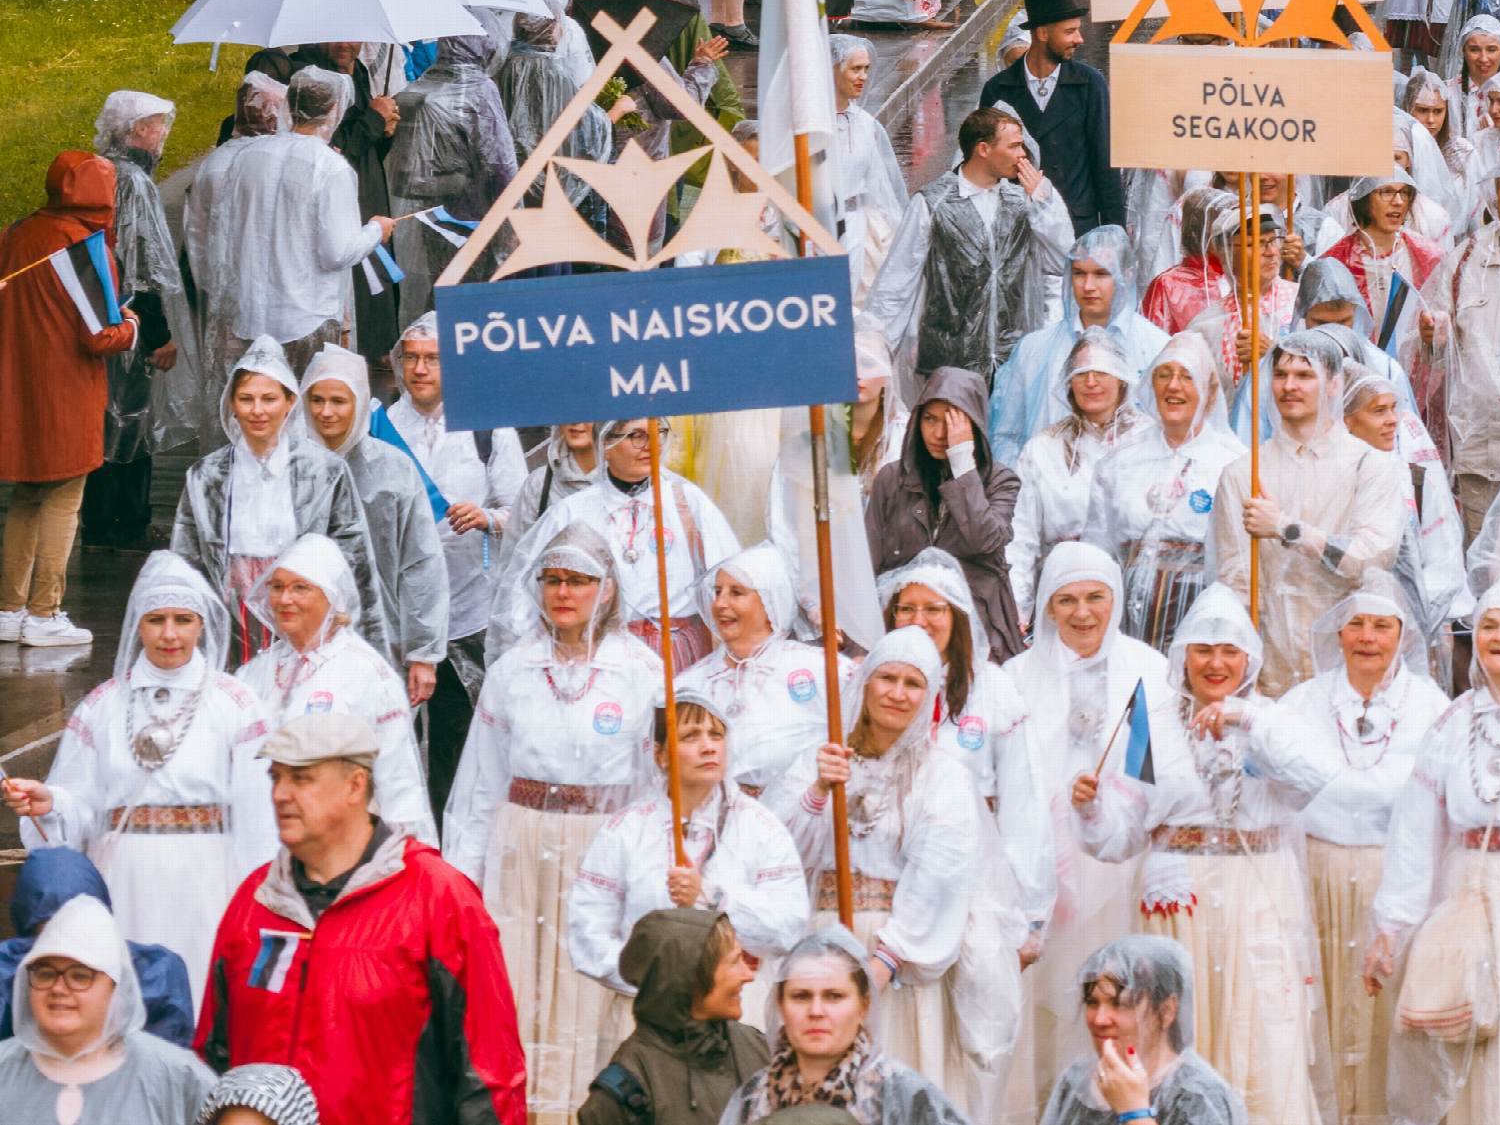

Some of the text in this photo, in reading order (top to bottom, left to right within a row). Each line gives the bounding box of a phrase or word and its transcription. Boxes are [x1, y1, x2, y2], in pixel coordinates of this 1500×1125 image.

[1202, 77, 1286, 108] PÕLVA
[1172, 115, 1317, 143] SEGAKOOR
[454, 293, 838, 356] PÕLVA NAISKOOR
[609, 359, 690, 398] MAI
